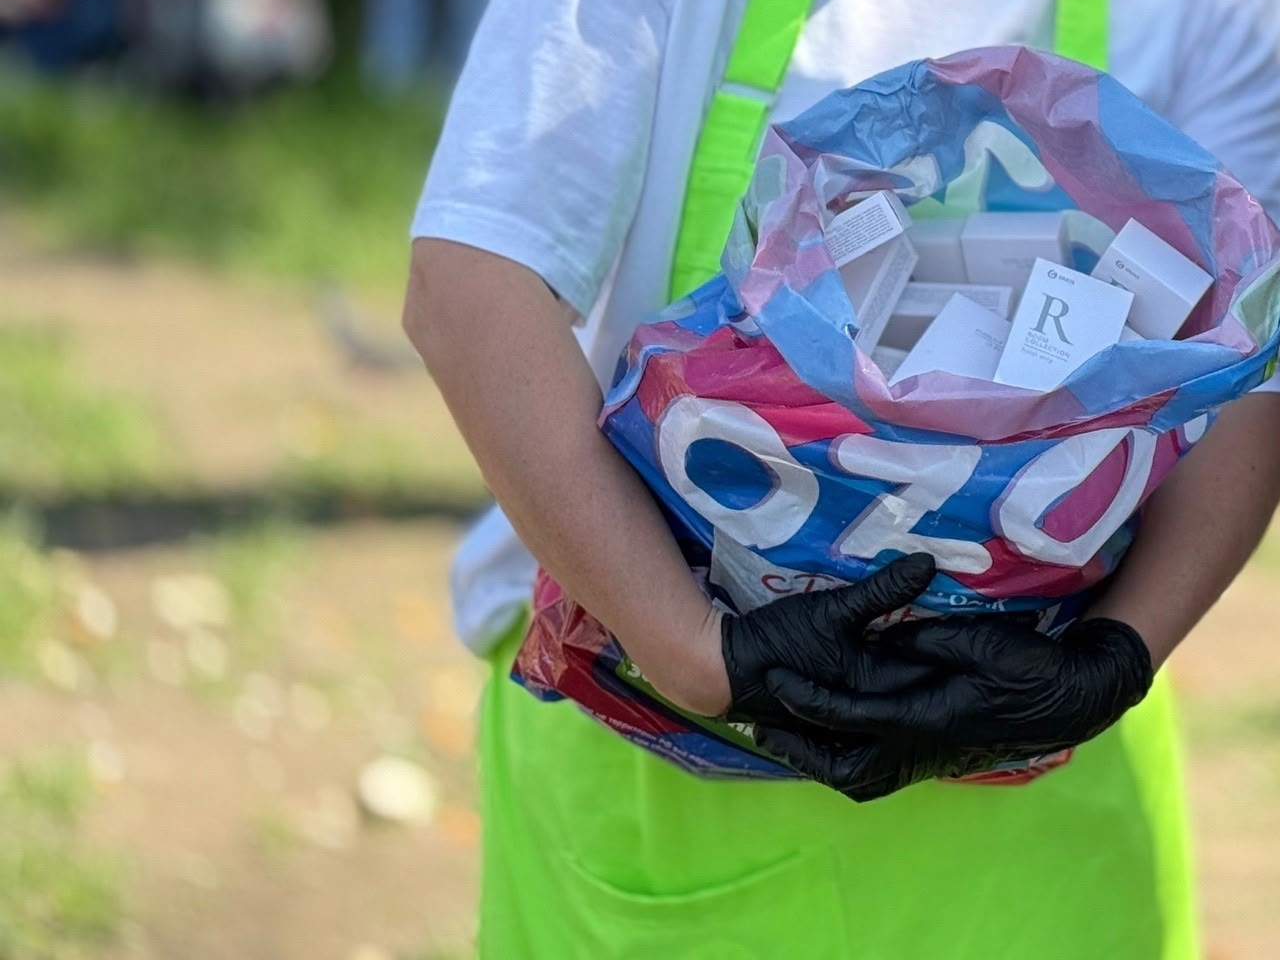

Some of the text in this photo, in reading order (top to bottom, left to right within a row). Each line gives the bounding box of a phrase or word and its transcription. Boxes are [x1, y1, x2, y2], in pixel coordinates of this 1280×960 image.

[1029, 292, 1075, 346] R
[1025, 336, 1071, 359] COLLECTION
[657, 394, 1208, 575] OZO
